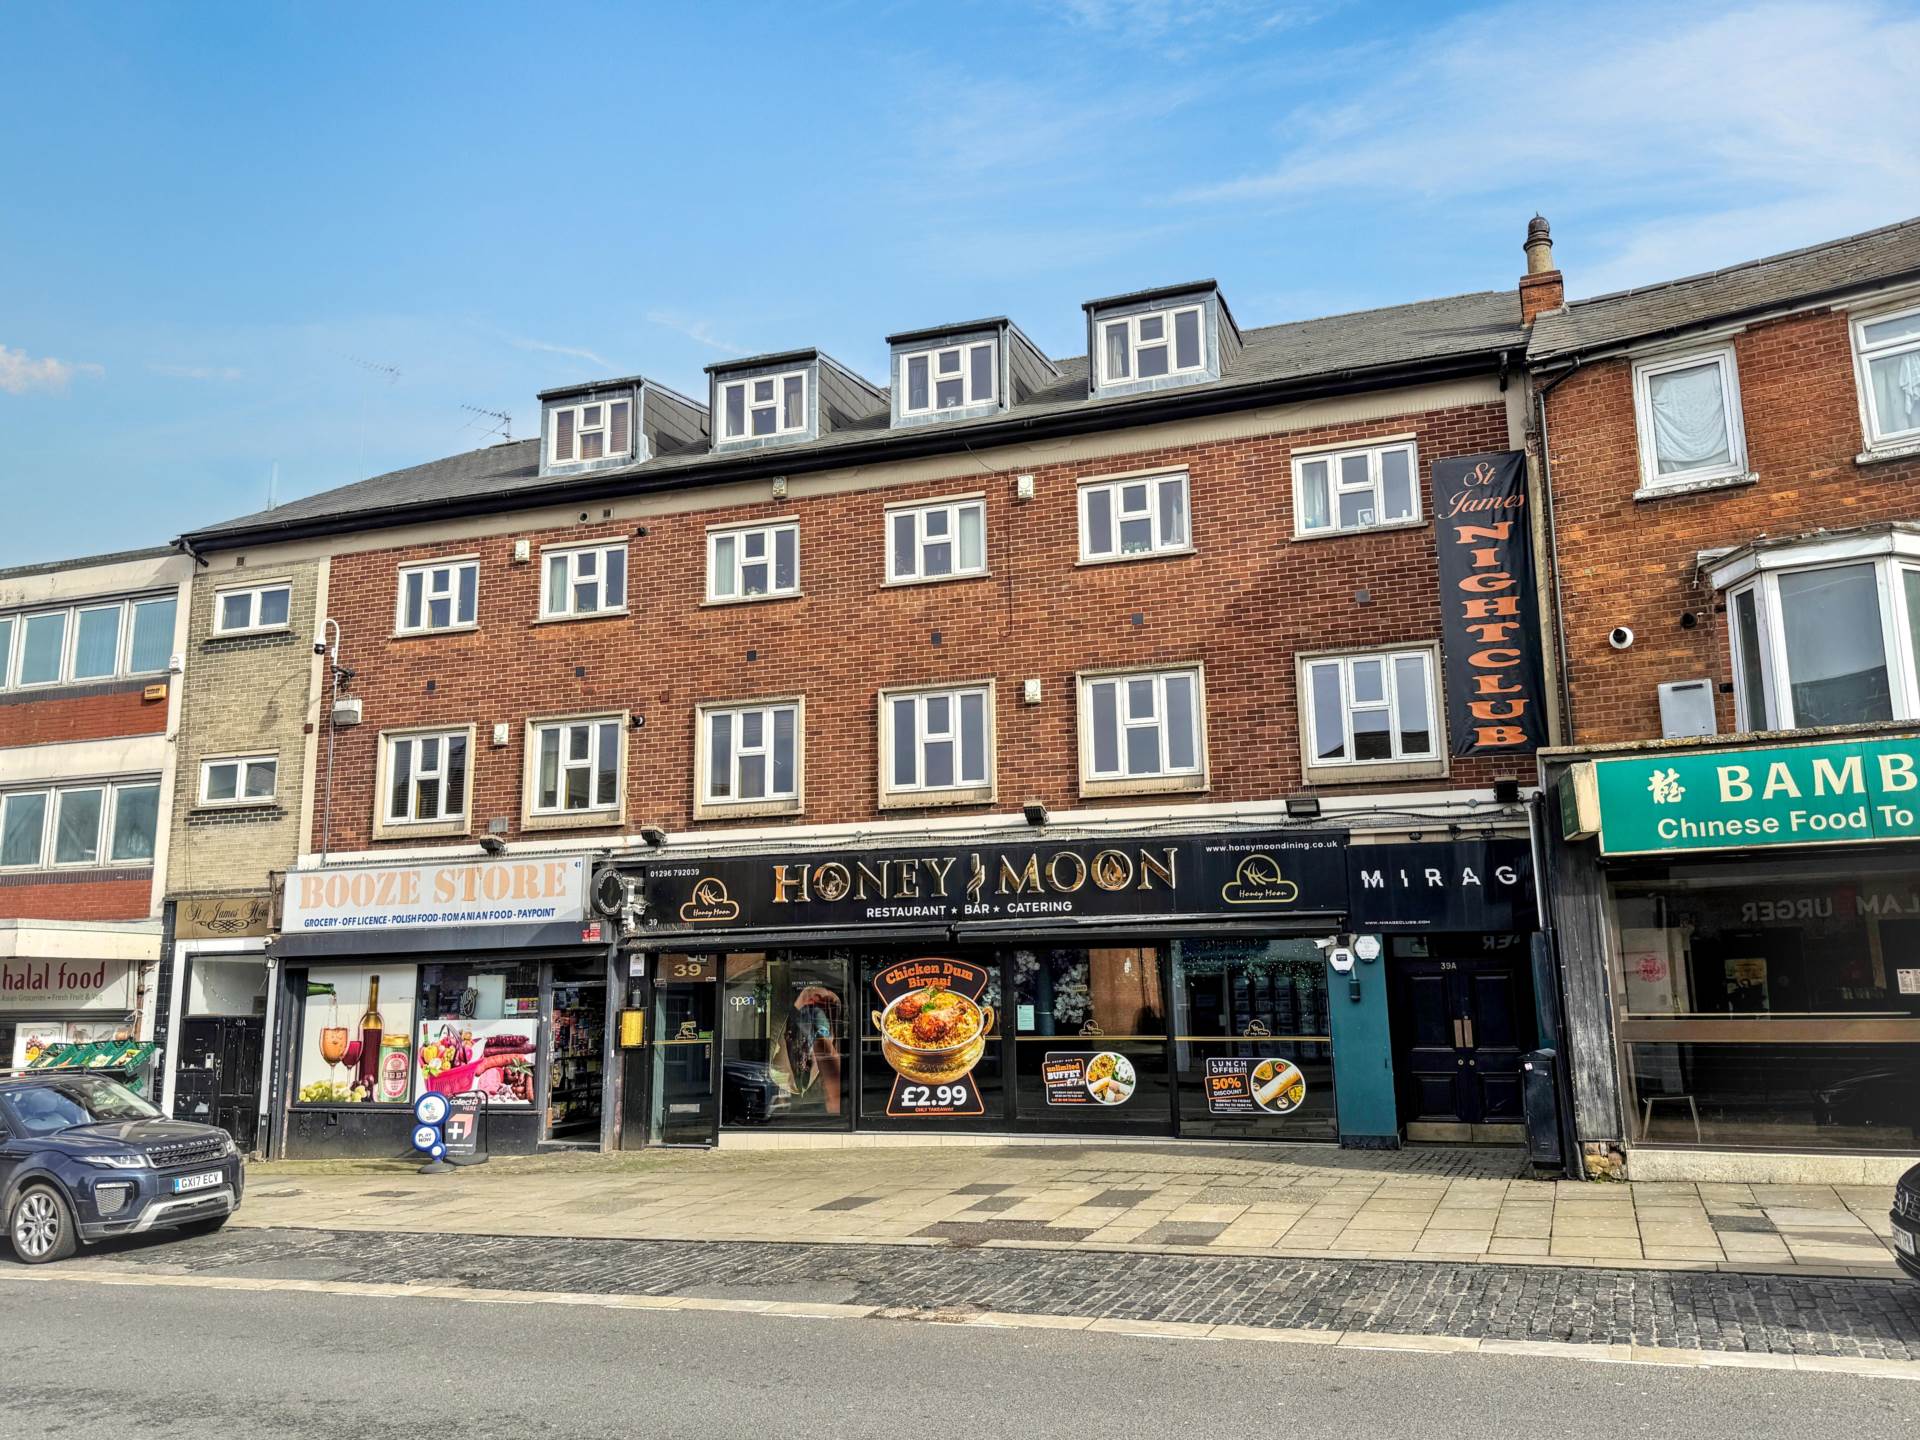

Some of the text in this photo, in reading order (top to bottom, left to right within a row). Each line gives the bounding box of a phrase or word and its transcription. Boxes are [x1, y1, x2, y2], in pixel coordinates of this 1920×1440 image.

[1464, 462, 1495, 488] St
[1438, 490, 1524, 520] James
[1453, 521, 1530, 746] NIGHTCLUB
[1716, 753, 1918, 802] BAMB
[1658, 805, 1914, 839] Chinese Food To
[1205, 841, 1338, 853] www.honeymoondining.co.uk
[650, 869, 700, 878] 01296 792039
[772, 847, 1178, 903] HONEY MOON
[299, 862, 567, 909] BOOZE STORE
[1239, 888, 1288, 899] Honey Moon
[304, 908, 556, 927] GROCERY OFF LICENCE POLISH FOOD ROMANIAN FOOD PAYPOINT
[866, 901, 1073, 918] RESTAURANT BAR CATERING
[649, 918, 658, 926] 39
[673, 963, 702, 977] 39
[885, 962, 974, 985] Chicken Dum
[1440, 961, 1457, 970] 39A
[2, 961, 106, 990] halal food
[907, 975, 952, 988] Biryani
[730, 996, 756, 1011] open
[1046, 1062, 1080, 1073] unlimited
[1047, 1069, 1080, 1080] BUFFET
[1212, 1077, 1241, 1090] 50%
[901, 1085, 967, 1107] £2.99
[181, 1173, 219, 1189] GX17 ECV
